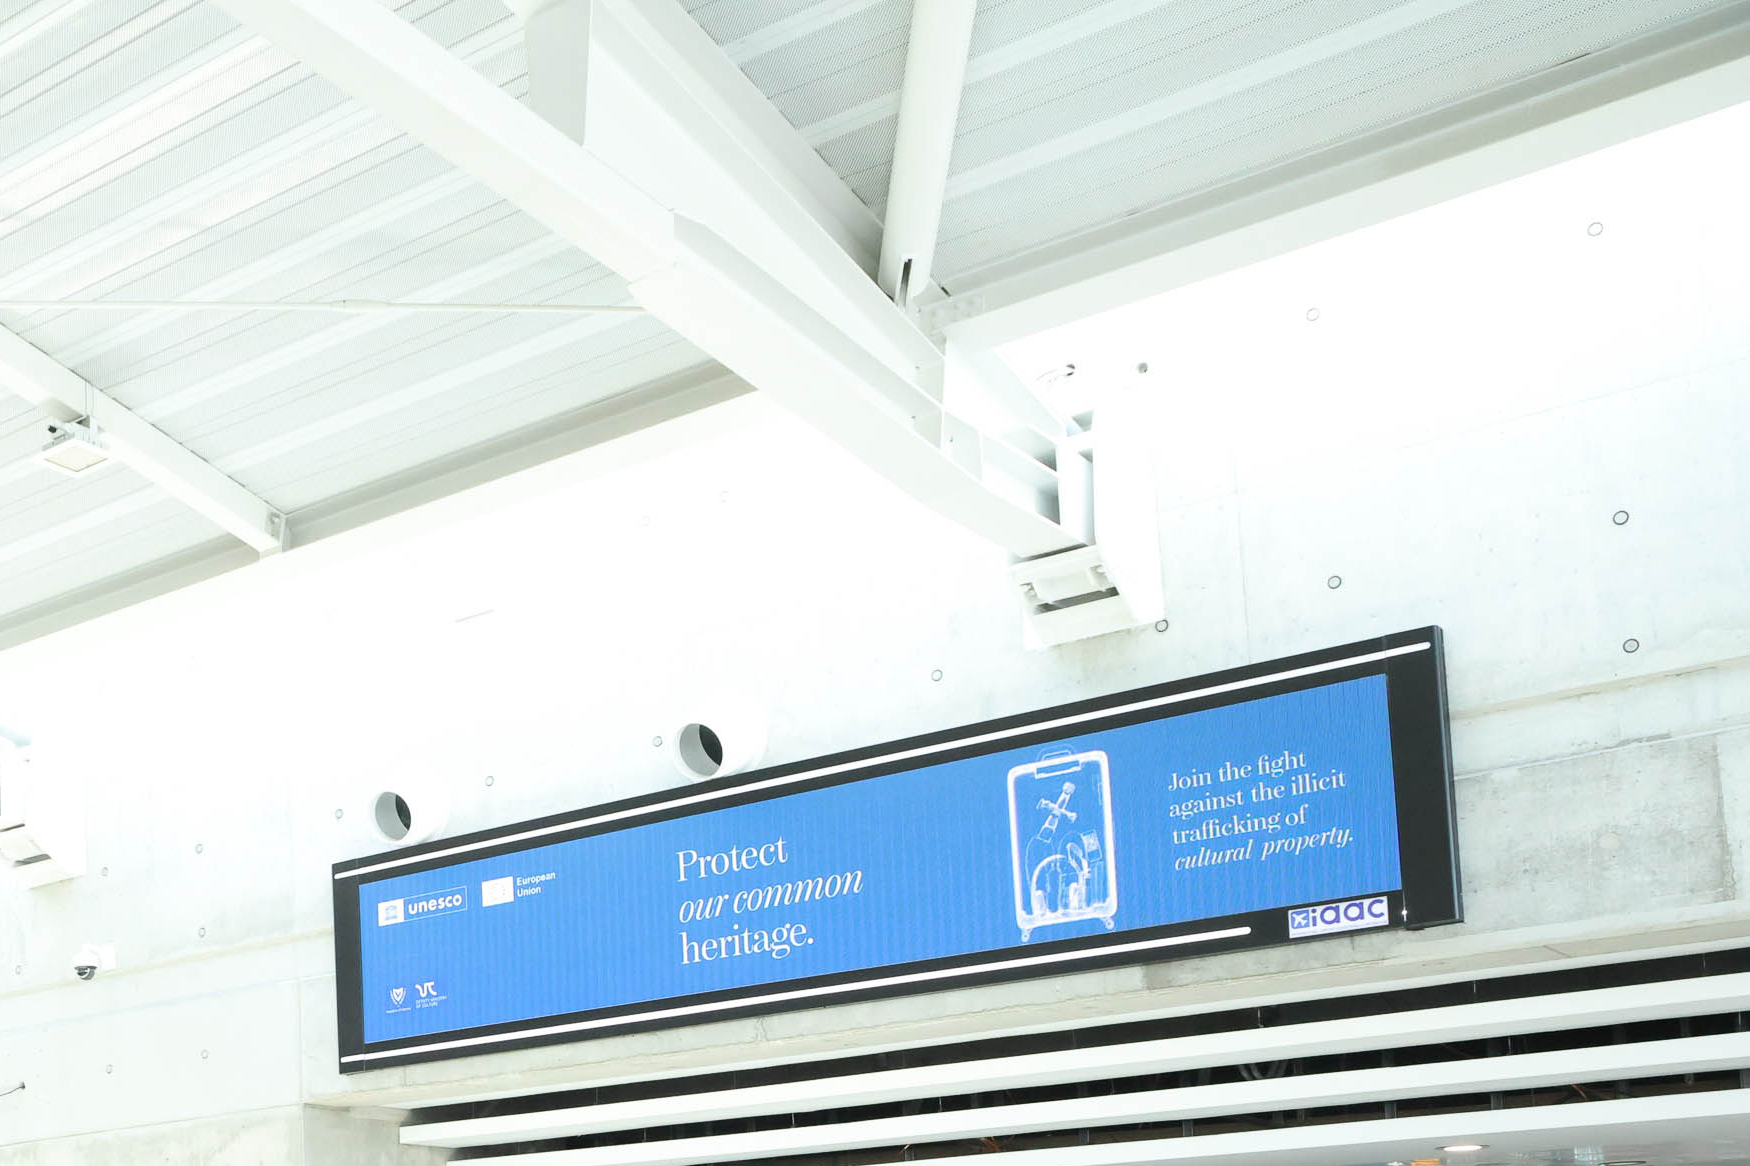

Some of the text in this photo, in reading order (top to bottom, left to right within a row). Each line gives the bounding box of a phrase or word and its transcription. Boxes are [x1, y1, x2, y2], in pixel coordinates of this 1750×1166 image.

[1168, 750, 1307, 791] Join the fight
[1169, 769, 1347, 820] against the illicit
[1172, 803, 1309, 845] trafficking of
[675, 835, 788, 882] Protect
[1174, 826, 1354, 871] cultural property.
[516, 871, 556, 887] European
[516, 885, 542, 897] Union
[678, 869, 864, 923] our common
[408, 893, 463, 915] unesco
[1311, 898, 1385, 927] iaac
[678, 923, 814, 965] heritage.
